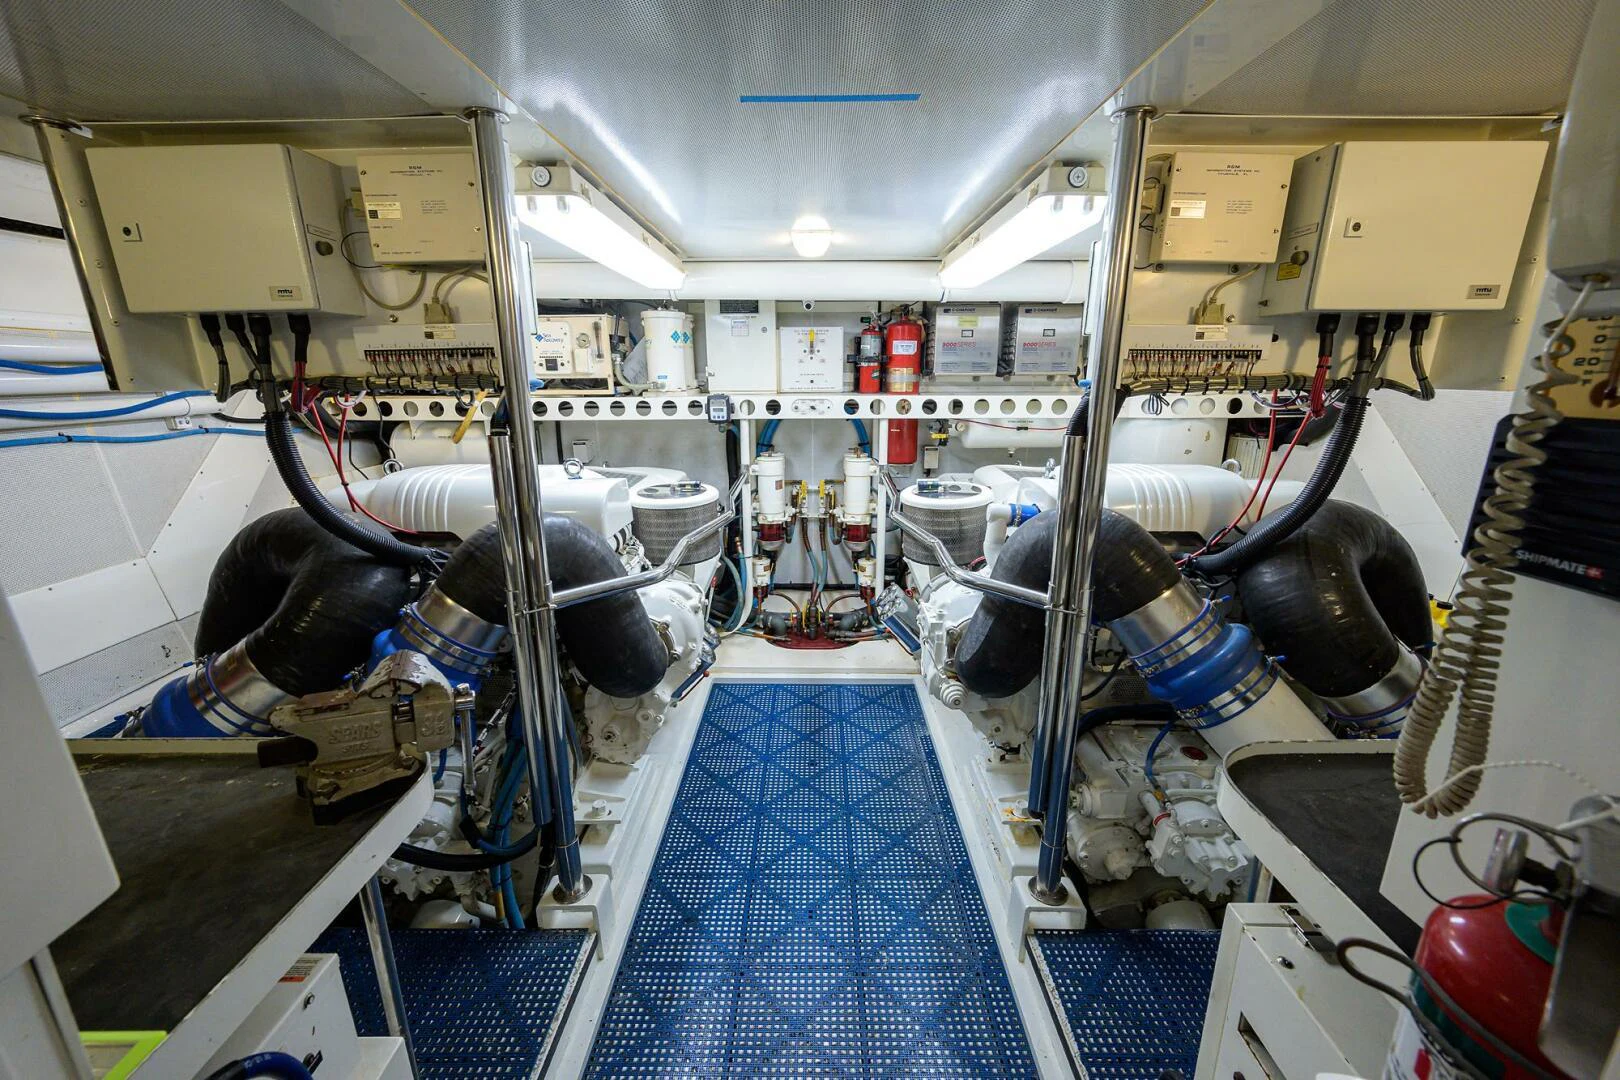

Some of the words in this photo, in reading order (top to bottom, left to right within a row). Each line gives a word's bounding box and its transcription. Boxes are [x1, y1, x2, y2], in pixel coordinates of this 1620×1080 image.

[1594, 334, 1607, 344] 0
[1573, 357, 1601, 366] 20
[1515, 549, 1587, 575] SHIPMATE
